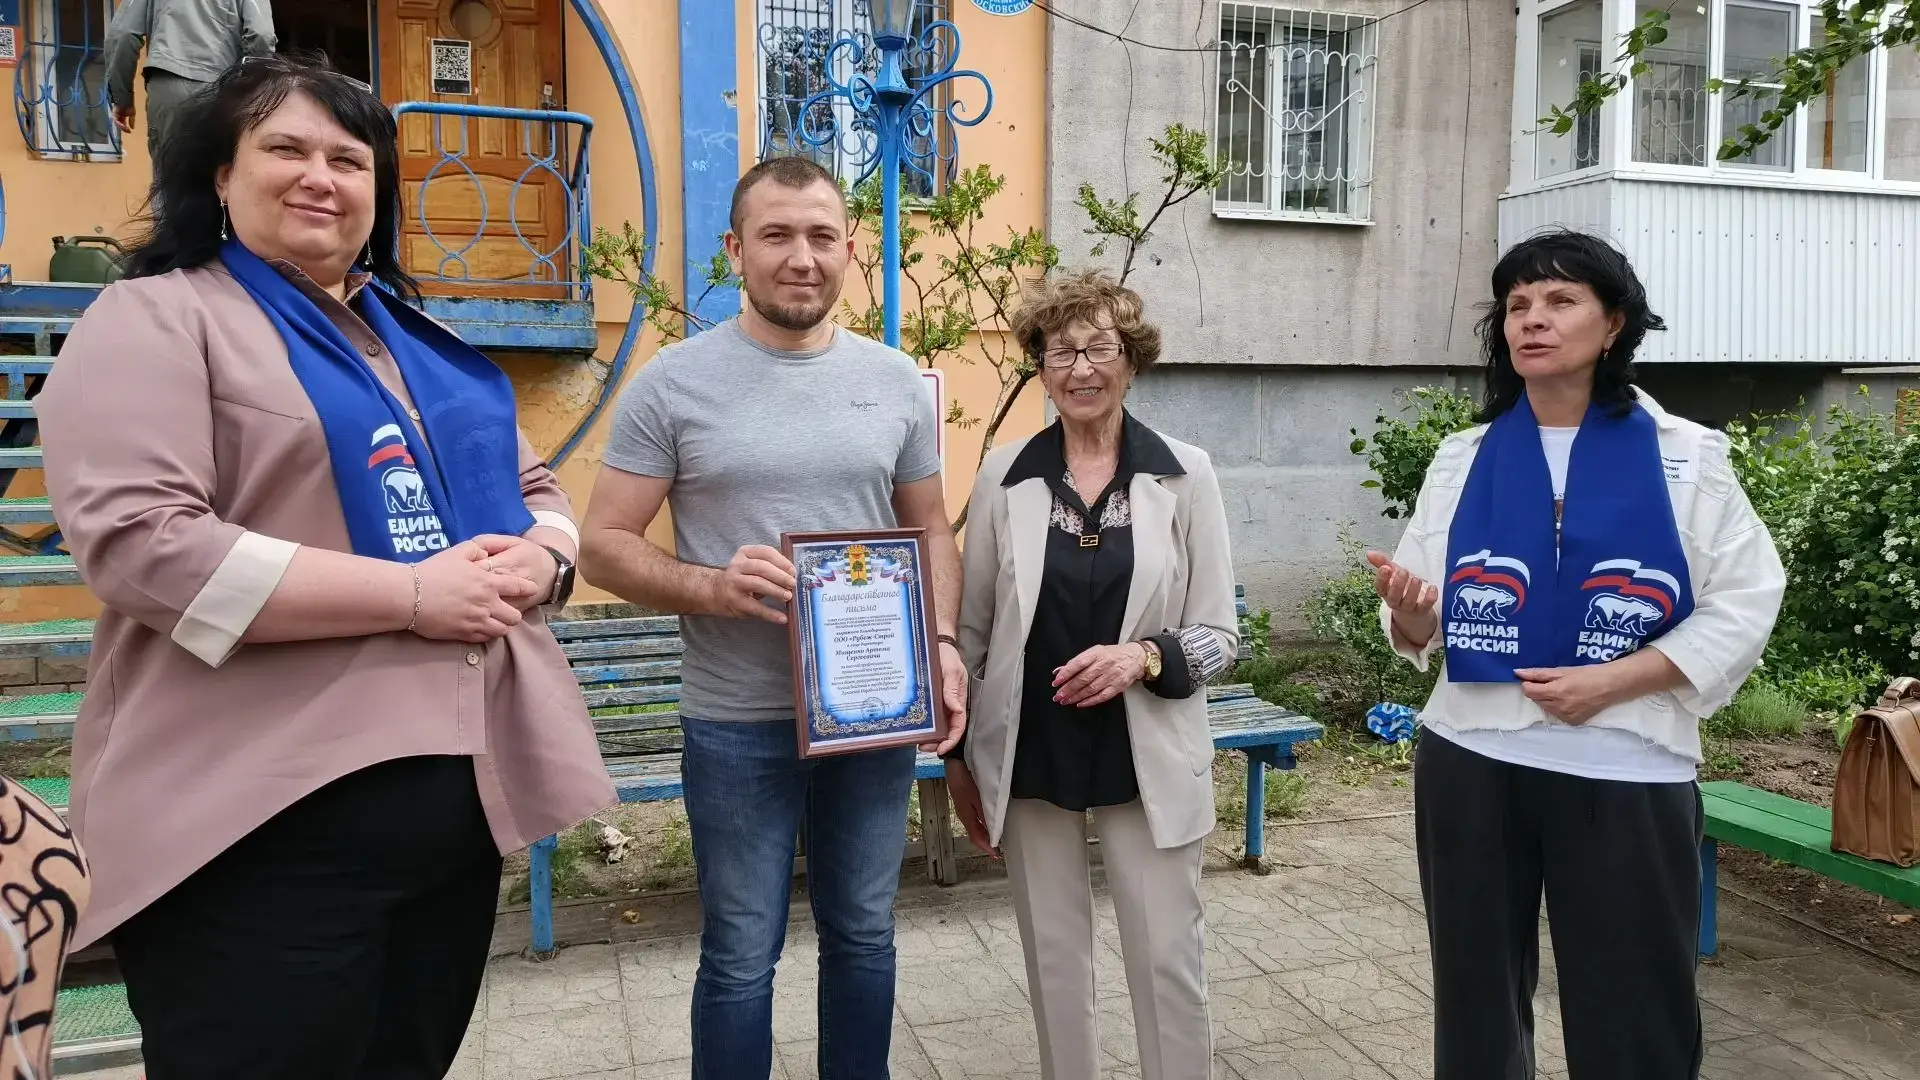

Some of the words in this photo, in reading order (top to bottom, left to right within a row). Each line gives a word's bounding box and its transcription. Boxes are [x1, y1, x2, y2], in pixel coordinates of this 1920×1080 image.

[976, 0, 1031, 13] ОСКОВСКИ
[388, 515, 442, 535] ЕДИН
[392, 533, 450, 553] РОССИ
[1447, 622, 1519, 638] ЕДИНАЯ
[1446, 635, 1519, 654] РОССИЯ
[1578, 631, 1639, 653] ЕДИНА
[1576, 645, 1625, 661] РОС
